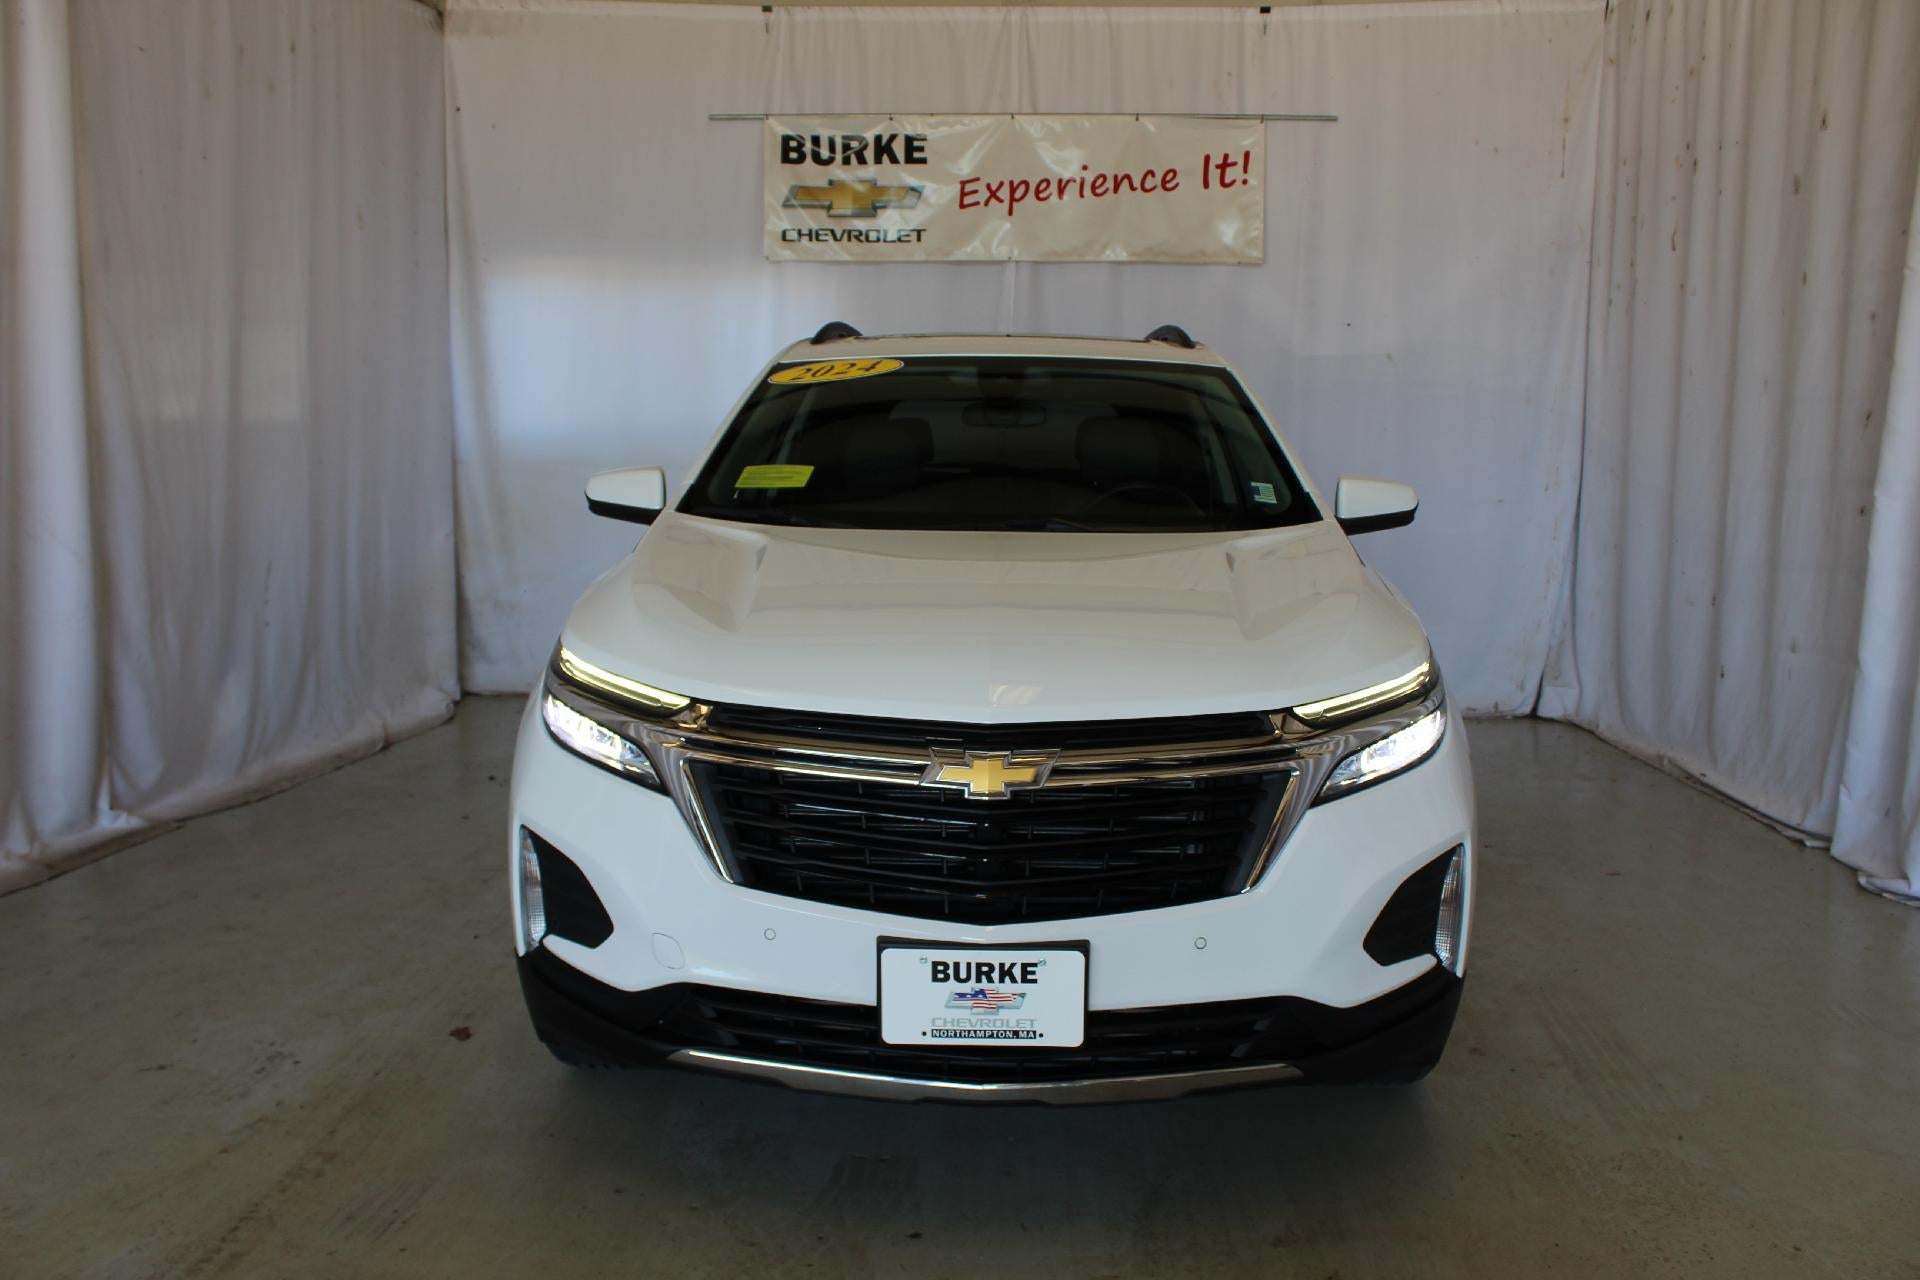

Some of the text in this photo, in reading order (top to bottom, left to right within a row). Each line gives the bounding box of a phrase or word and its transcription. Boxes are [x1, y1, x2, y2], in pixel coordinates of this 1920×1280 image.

[780, 133, 928, 166] BURKE
[957, 150, 1252, 215] Experience It!
[781, 228, 927, 244] CHEVROLET
[789, 360, 882, 381] 2024
[931, 960, 1039, 984] BURKE
[931, 1016, 1038, 1029] CHEVROLET
[1018, 1031, 1035, 1039] MA
